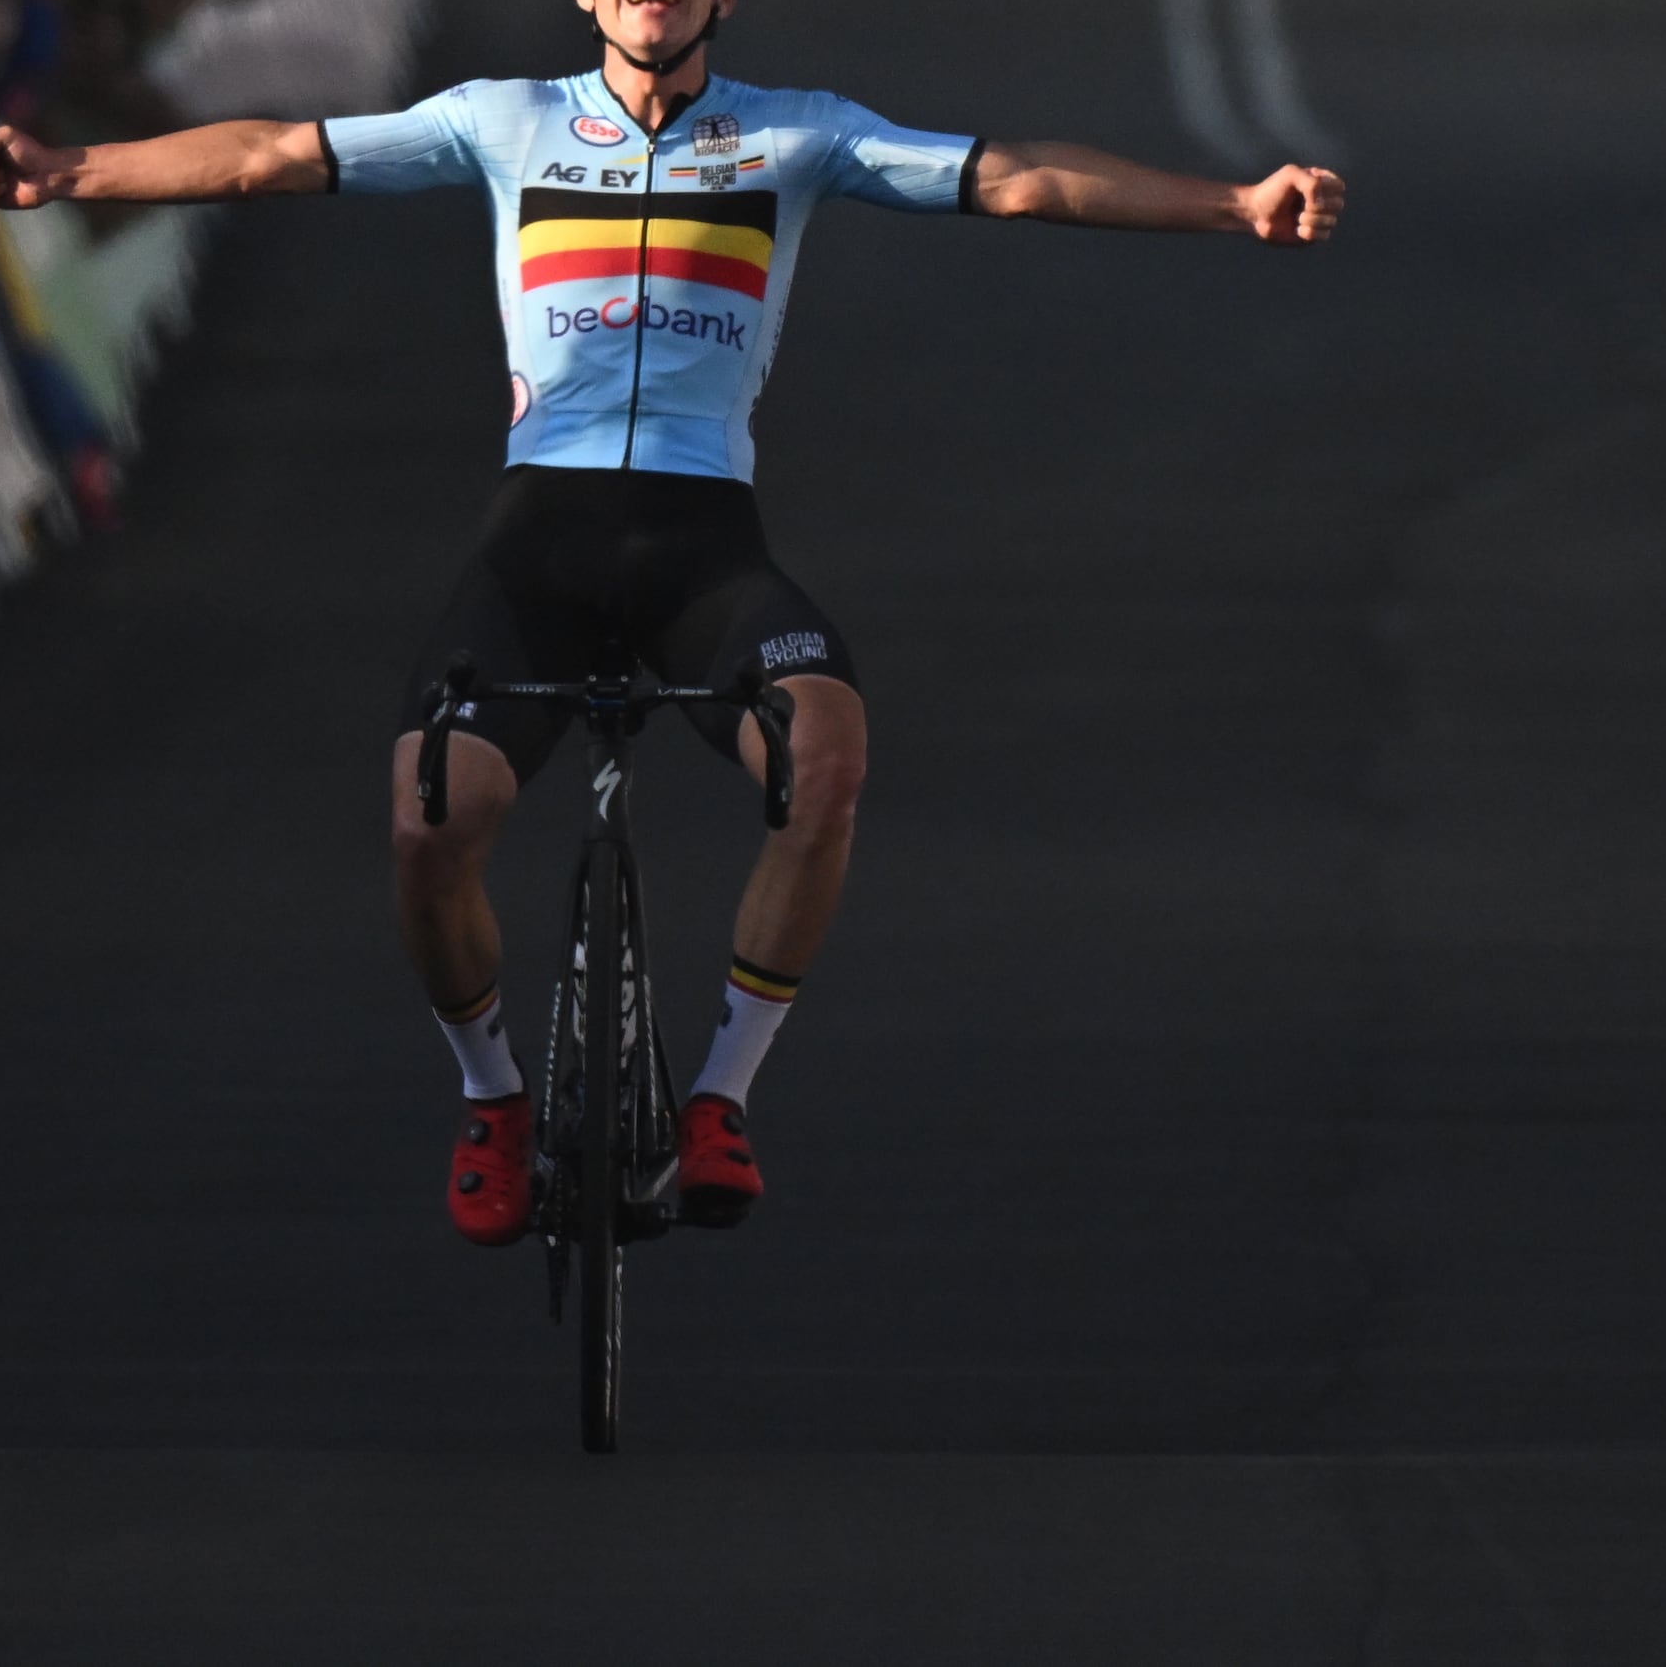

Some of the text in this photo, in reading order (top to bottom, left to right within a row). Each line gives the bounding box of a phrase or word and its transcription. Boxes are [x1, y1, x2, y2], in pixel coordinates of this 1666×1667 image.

[540, 161, 587, 184] AG
[599, 168, 641, 188] EY
[699, 162, 737, 176] BELGIAN
[699, 174, 737, 186] CYCLING
[759, 631, 826, 656] BELGIAN
[763, 645, 829, 670] CYCLING
